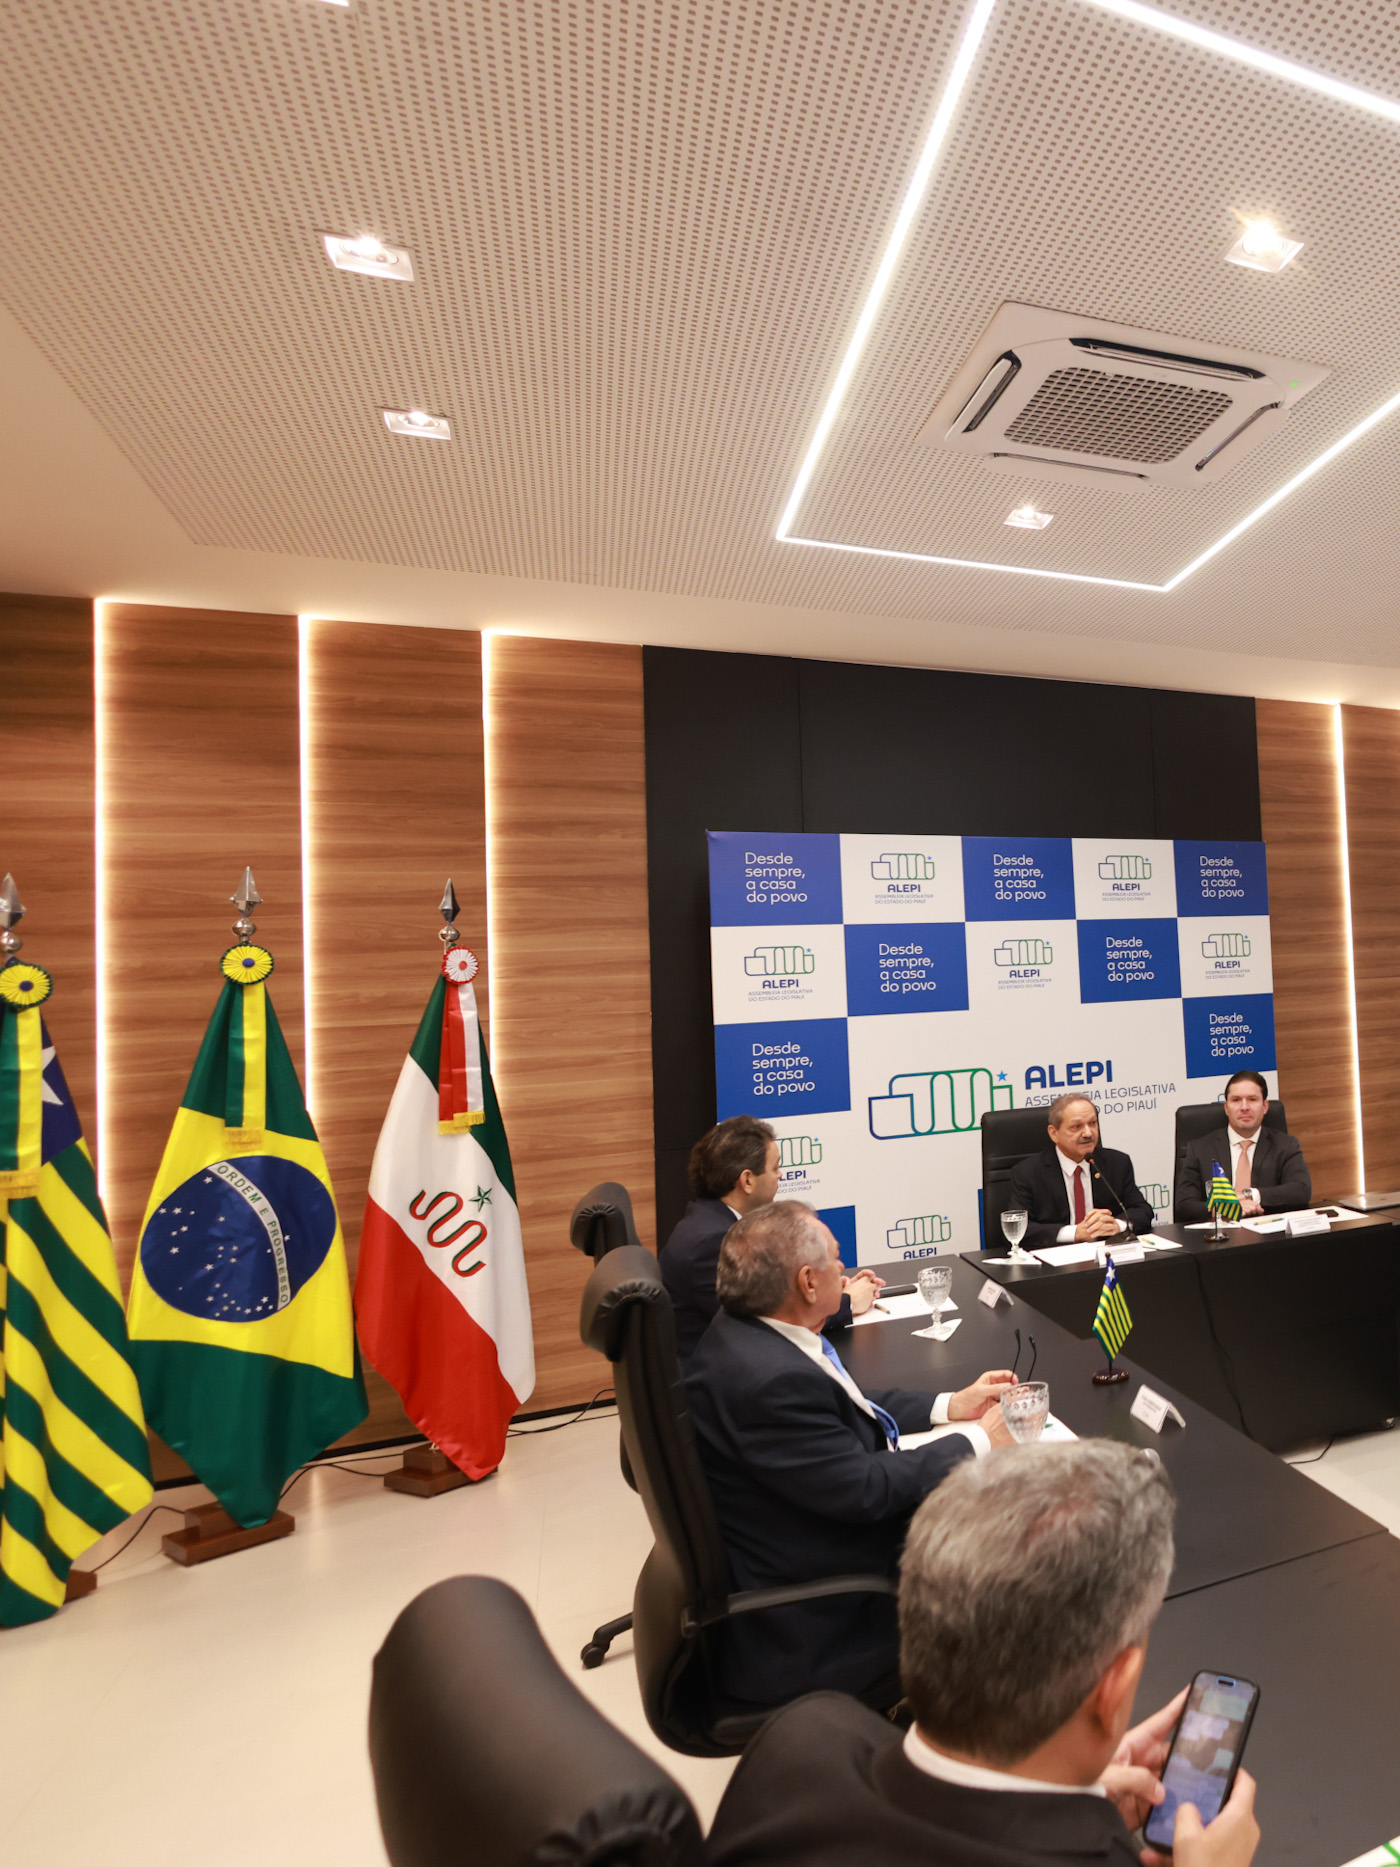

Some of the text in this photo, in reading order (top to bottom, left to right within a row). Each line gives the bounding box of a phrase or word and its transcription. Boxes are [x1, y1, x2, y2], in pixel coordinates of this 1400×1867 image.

[745, 852, 793, 864] Desde
[994, 854, 1033, 865] Desde
[1200, 856, 1233, 866] Desde
[745, 866, 805, 879] sempre,
[994, 867, 1044, 879] sempre,
[1200, 867, 1242, 878] sempre,
[746, 879, 796, 889] a casa
[995, 879, 1036, 888] a casa
[1211, 878, 1236, 886] casa
[747, 891, 807, 905] do povo
[995, 889, 1046, 902] do povo
[1202, 888, 1244, 898] do povo
[1106, 937, 1142, 947] Desde
[879, 943, 922, 955] Desde
[1107, 949, 1152, 960] sempre,
[879, 956, 934, 969] sempre,
[1108, 960, 1145, 970] a casa
[880, 970, 925, 979] a casa
[1010, 970, 1040, 978] ALEPI
[1108, 970, 1154, 982] do povo
[762, 980, 799, 988] ALEPI
[881, 980, 936, 993] do povo
[1210, 1014, 1243, 1024] Desde
[1210, 1025, 1252, 1036] sempre,
[1220, 1036, 1245, 1044] casa
[752, 1042, 800, 1055] Desde
[1211, 1046, 1254, 1058] do povo
[753, 1056, 813, 1069] sempre,
[754, 1069, 803, 1082] a casa
[1025, 1060, 1113, 1089] ALEPI
[754, 1082, 815, 1096] do povo
[1104, 1083, 1176, 1099] LEGISLATIVA
[1104, 1102, 1124, 1113] DO
[1126, 1098, 1157, 1112] PIAUÍ
[780, 1170, 807, 1181] LEPI
[217, 1164, 289, 1303] ORDEM E PROGRESSO
[904, 1248, 937, 1258] ALEPI
